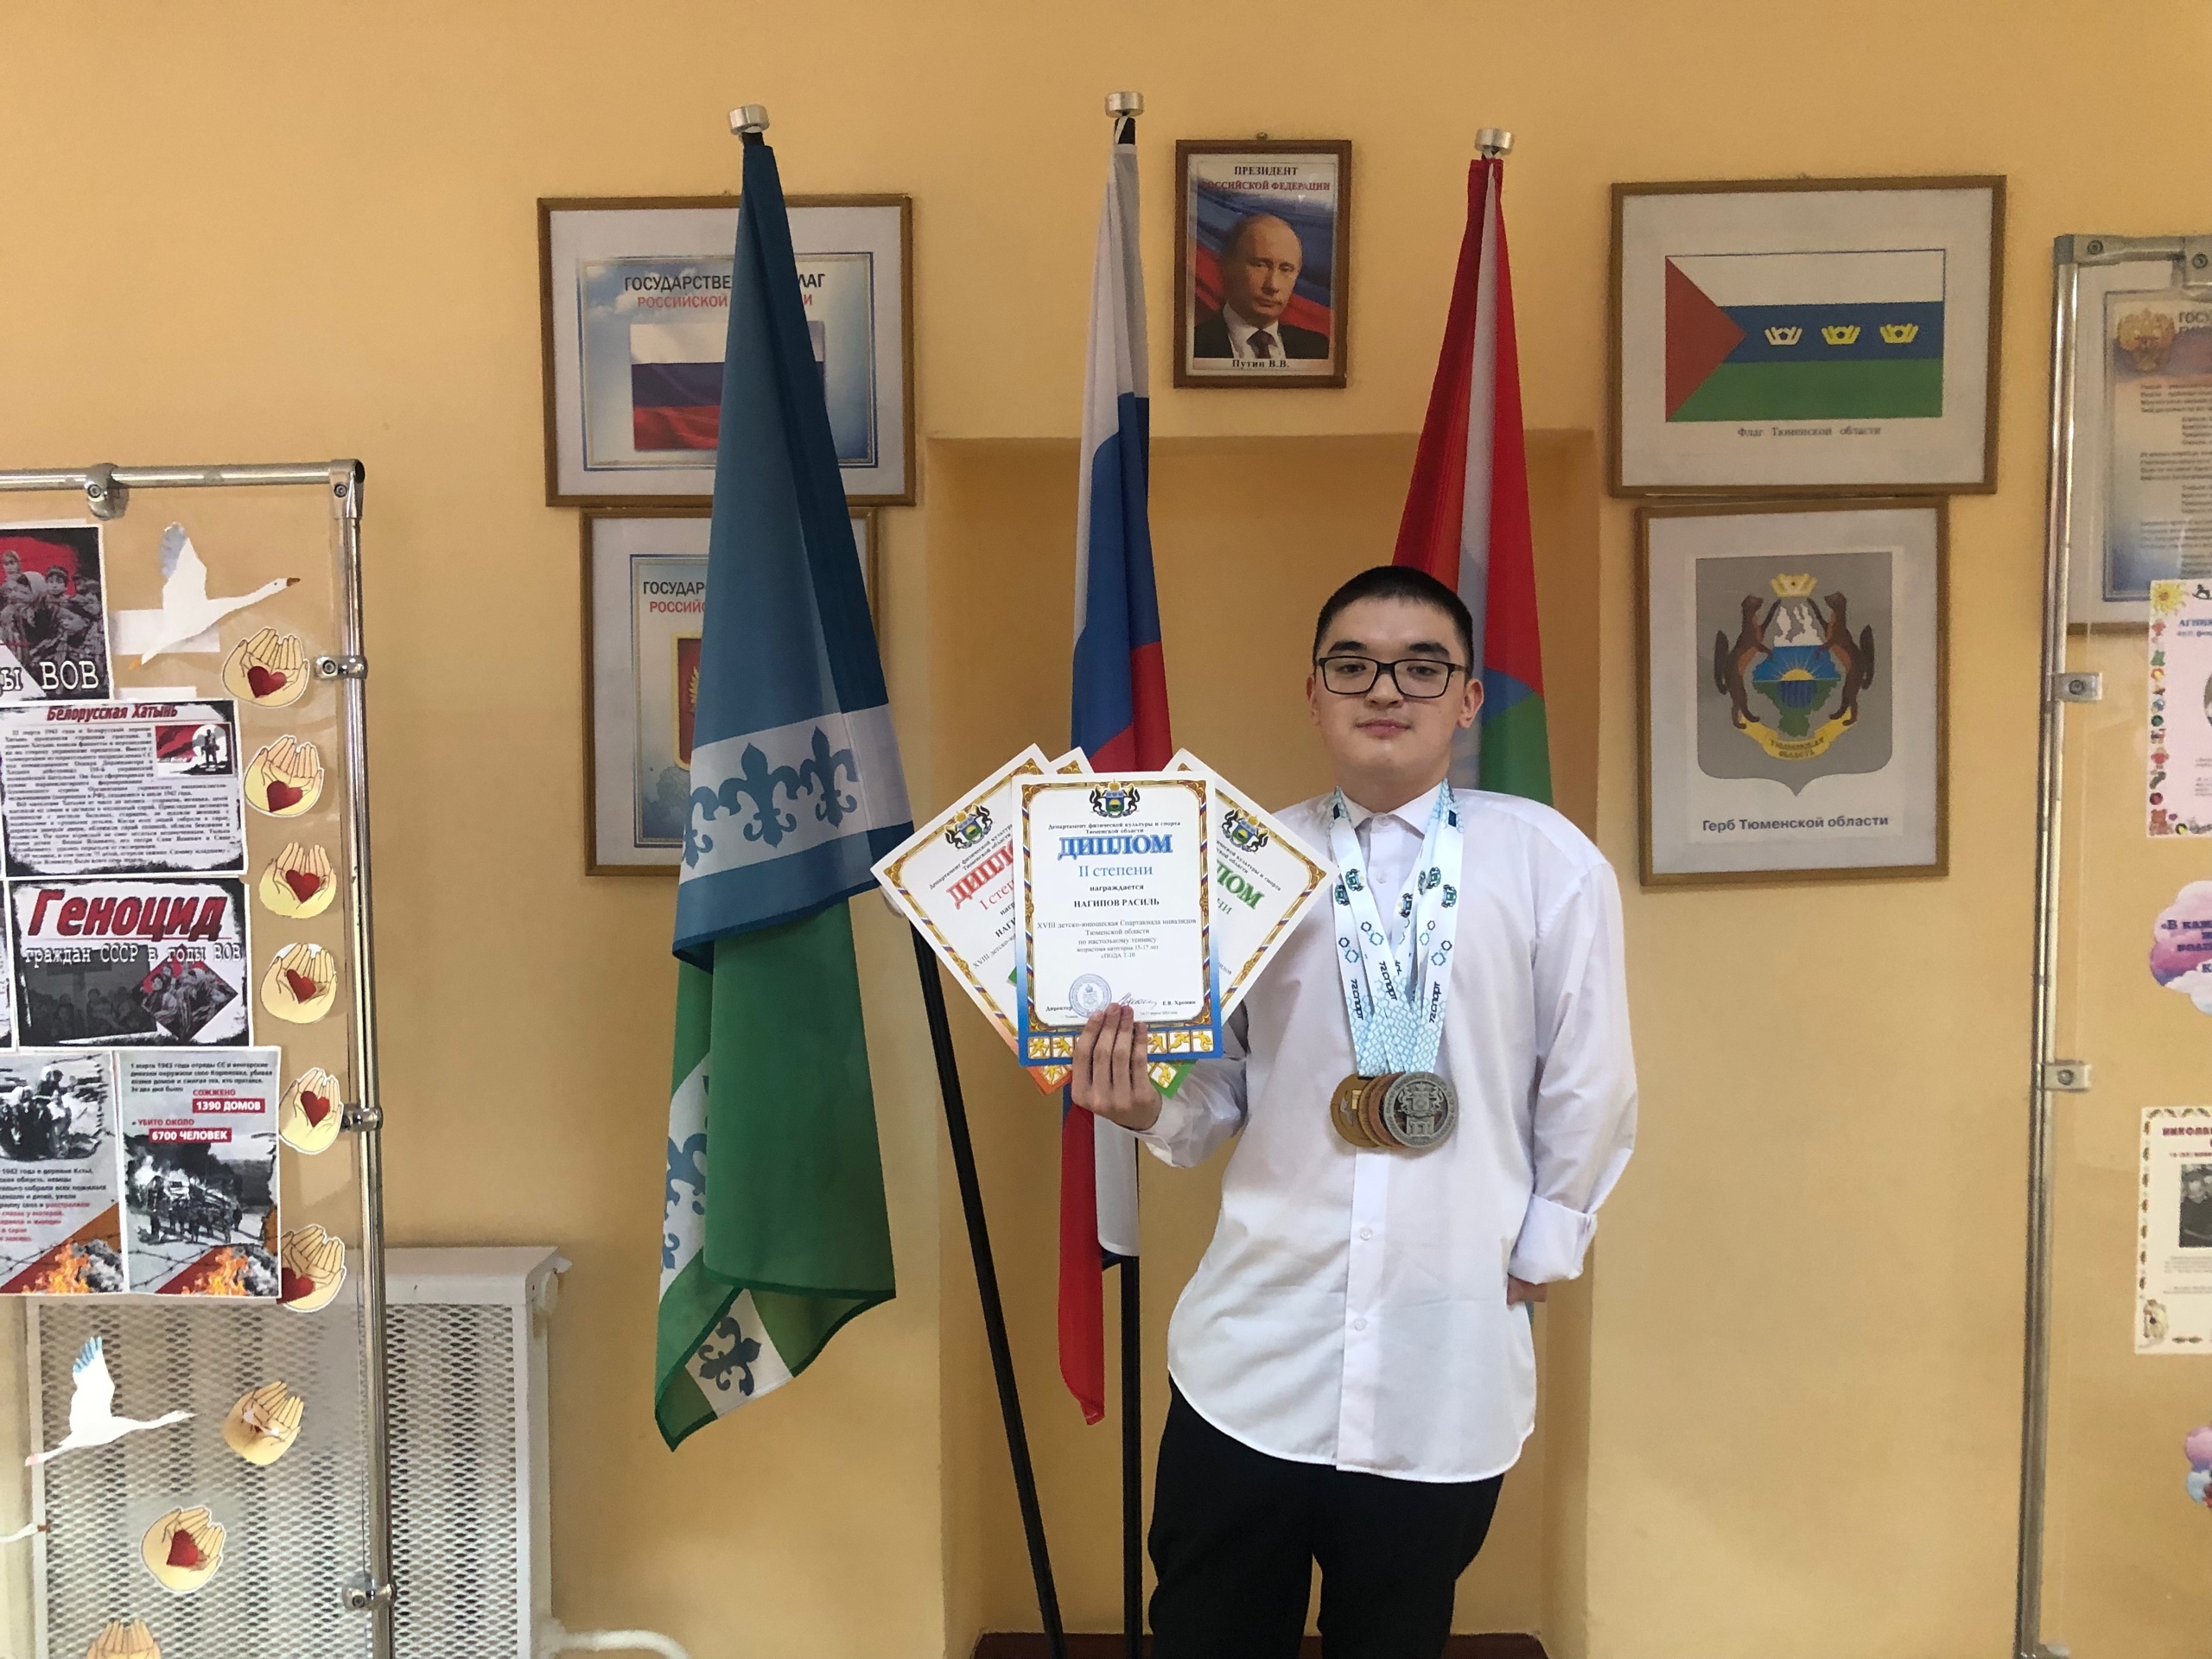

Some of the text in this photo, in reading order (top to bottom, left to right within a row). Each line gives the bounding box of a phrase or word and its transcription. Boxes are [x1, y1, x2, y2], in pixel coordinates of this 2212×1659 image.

[1234, 166, 1299, 176] ПРЕЗИДЕНТ
[1271, 181, 1331, 192] ФЕДЕРАЦИИ
[624, 273, 826, 293] ГОСУДАРСТВЕ ЛАГ
[637, 293, 728, 309] РОССИЙСКОЙ
[1231, 359, 1290, 369] Путин В.В.
[1737, 427, 1764, 437] Флаг
[1840, 425, 1881, 435] области
[649, 598, 706, 613] РОССИЙ
[39, 660, 100, 690] ВОВ
[47, 702, 179, 723] Белорусская Хатынь
[1702, 815, 1889, 833] Герб Тюменской области
[1057, 834, 1173, 861] ДИПЛОМ
[1078, 866, 1154, 877] II степени
[1090, 884, 1144, 893] награждается
[1217, 859, 1265, 910] ЛОМ
[1073, 898, 1160, 908] НАГИПОВ РАСИЛЬ
[27, 888, 228, 943] Геноцид
[1088, 938, 1129, 946] настольному
[25, 942, 244, 968] граждан СССР в годы ВОВ
[196, 1100, 261, 1112] 1390 ДОМОВ
[151, 1130, 228, 1141] 6700 ЧЕЛОВЕК
